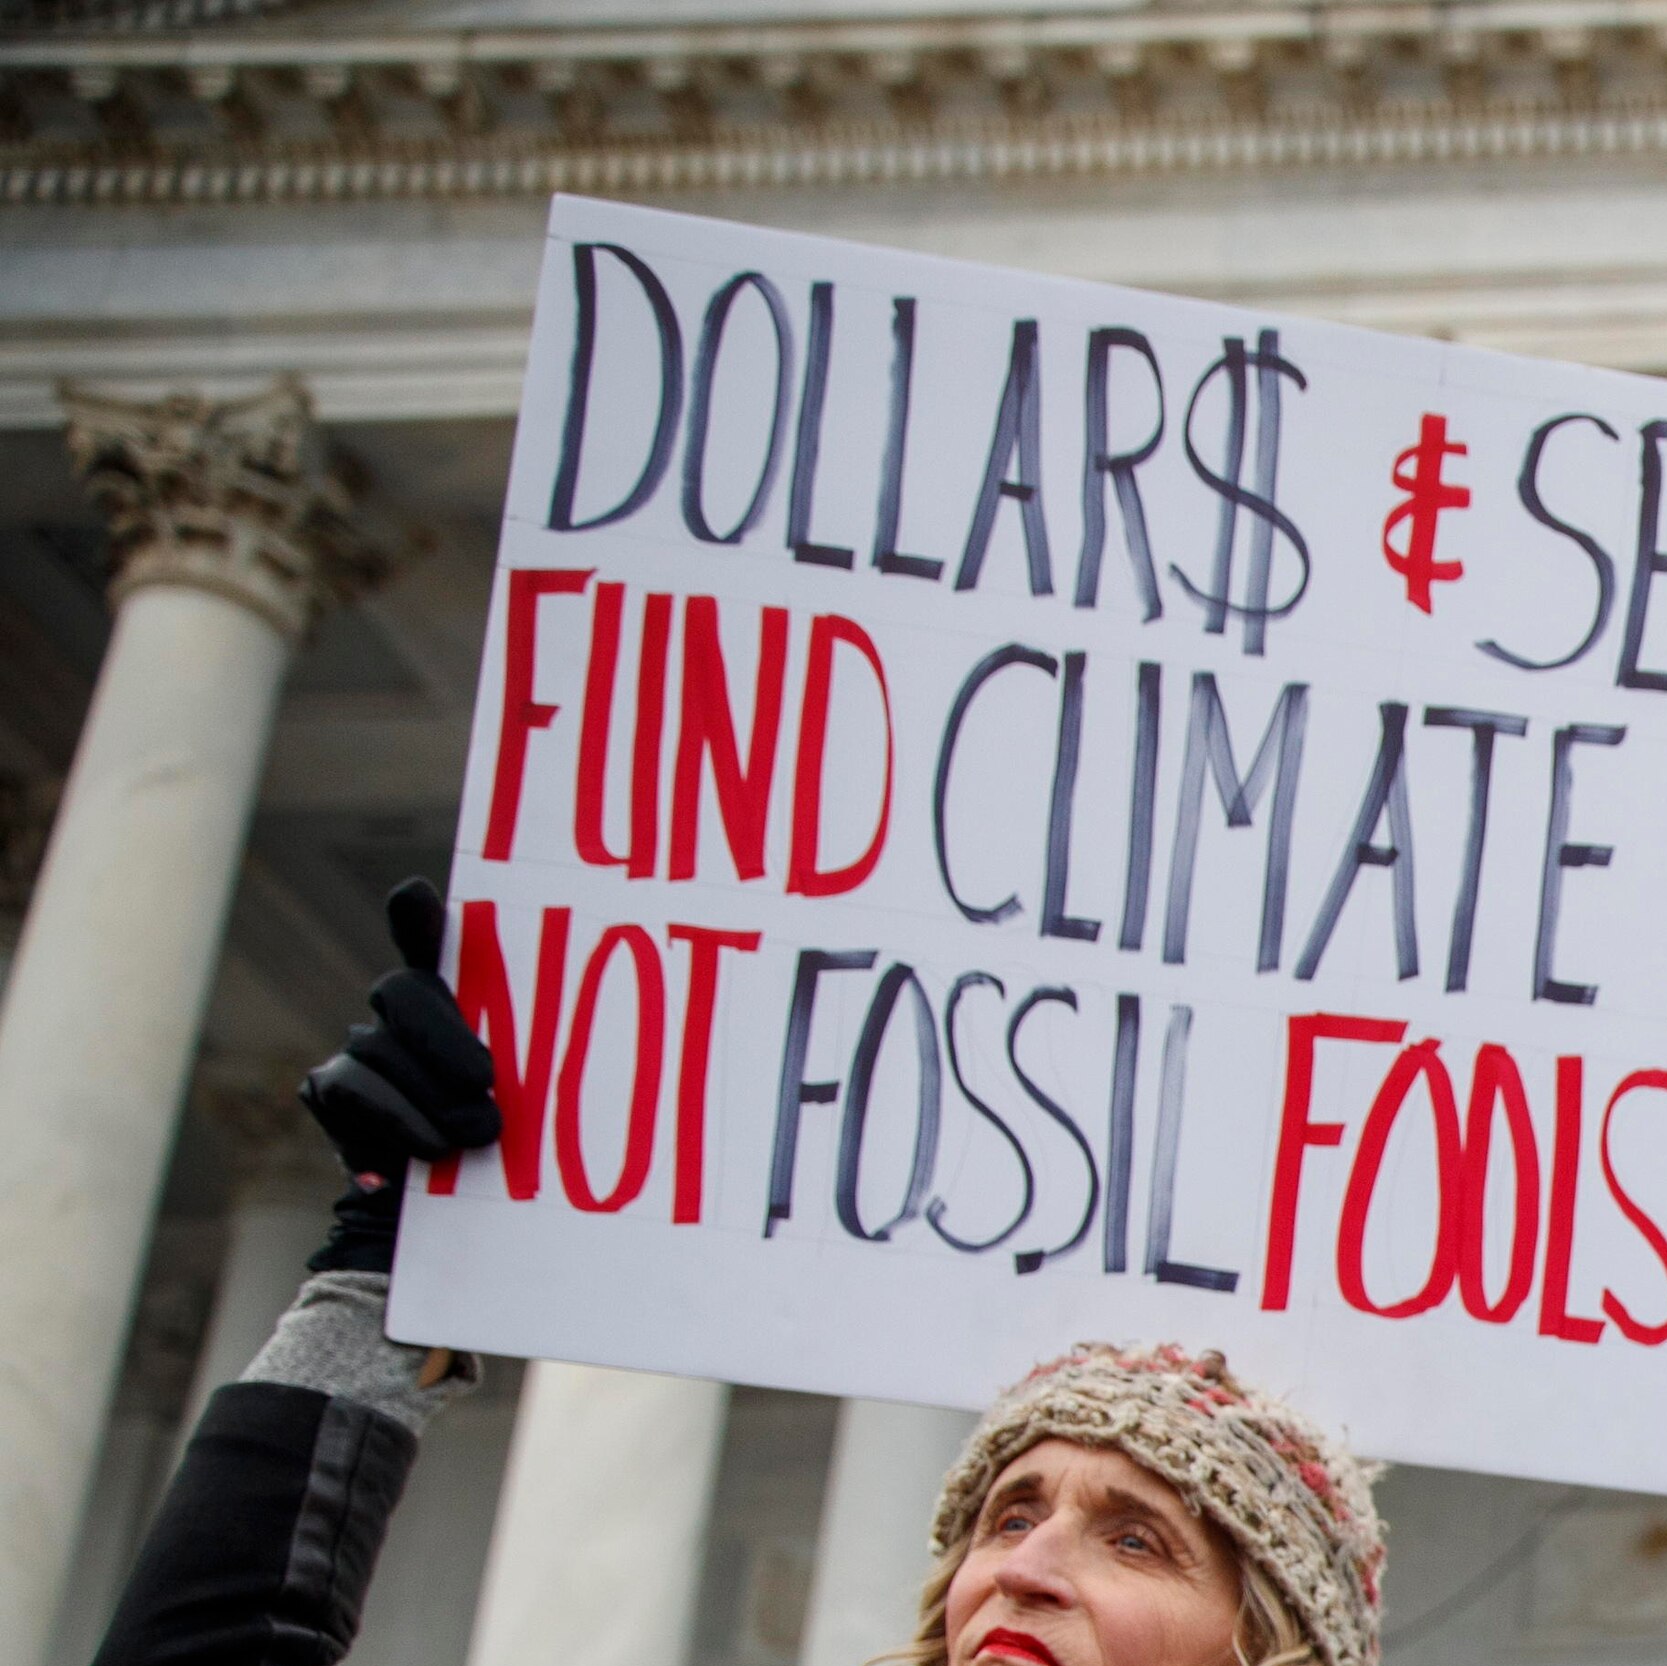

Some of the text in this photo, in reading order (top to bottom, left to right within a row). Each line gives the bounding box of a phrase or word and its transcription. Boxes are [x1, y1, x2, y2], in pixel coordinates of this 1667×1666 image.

[547, 241, 1311, 657] DOLLAR$
[482, 568, 893, 897] FUND
[933, 643, 1627, 1006] CLIMATE
[427, 900, 762, 1224] NOT
[762, 947, 1240, 1293] FOSSIL
